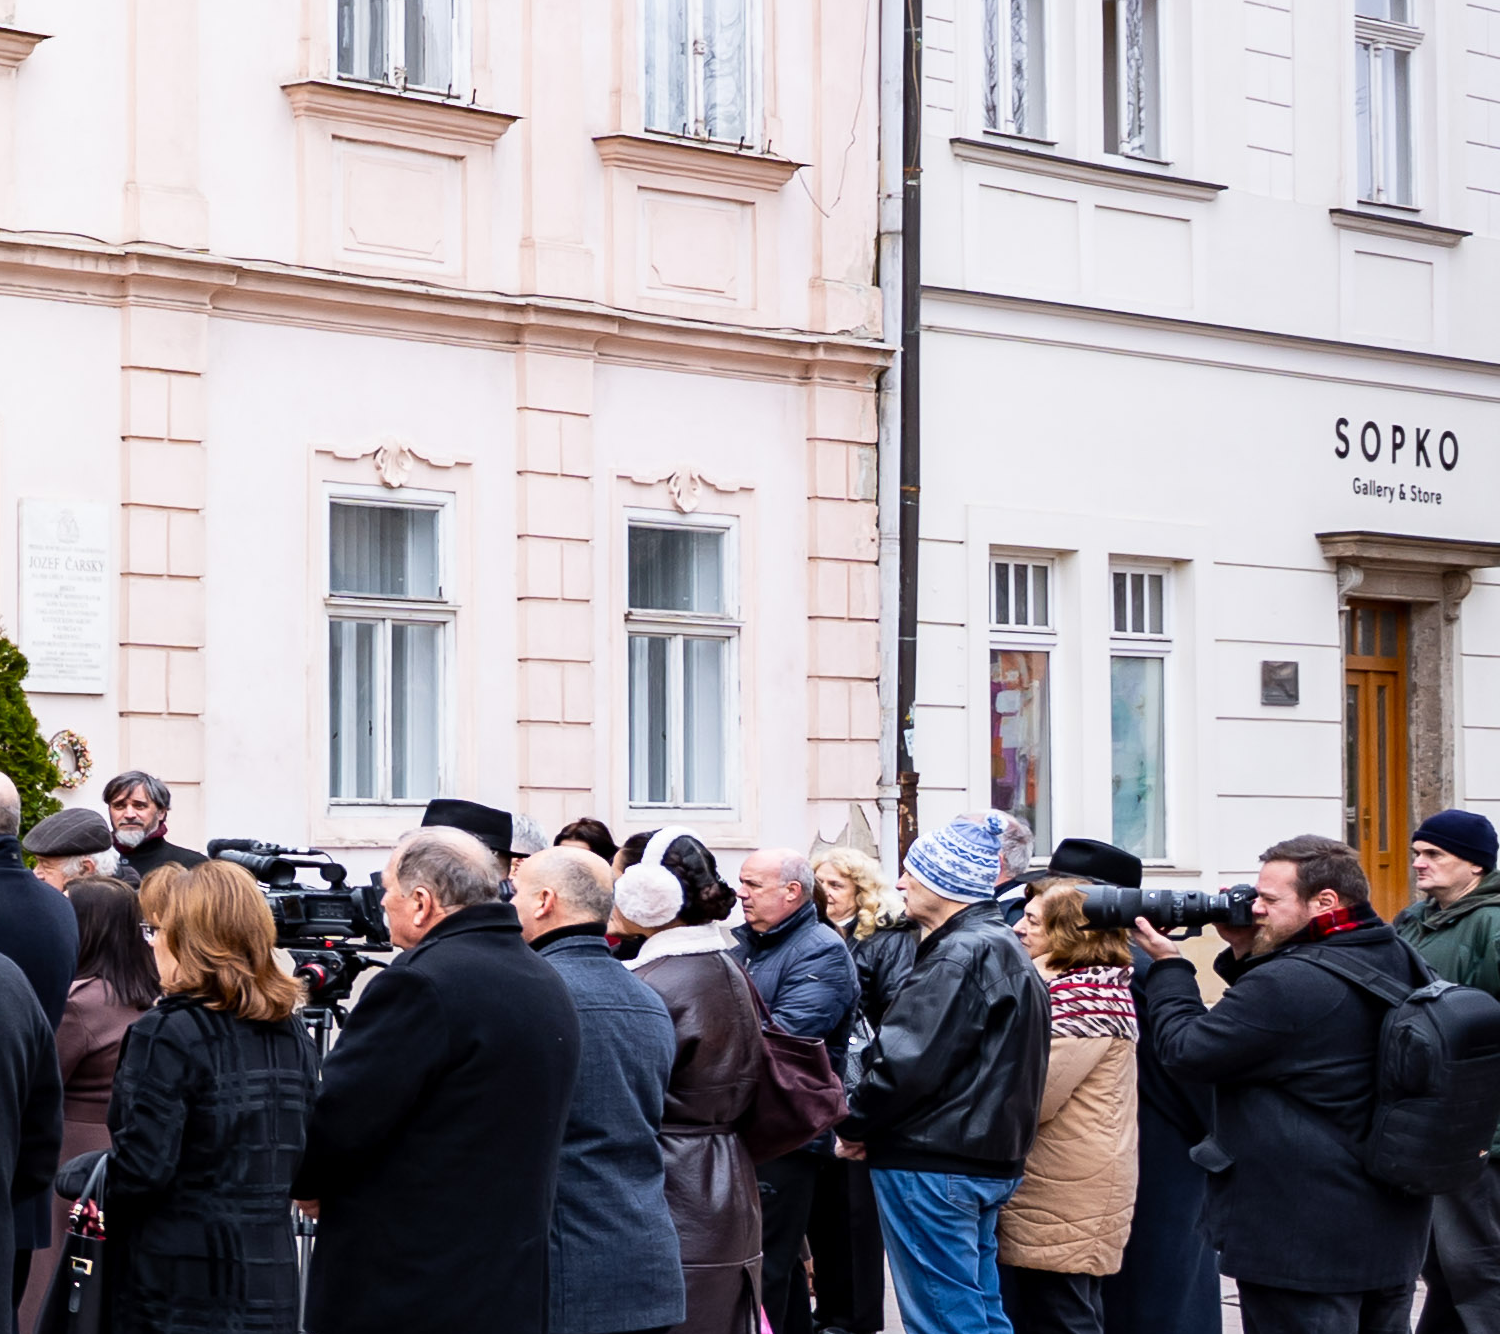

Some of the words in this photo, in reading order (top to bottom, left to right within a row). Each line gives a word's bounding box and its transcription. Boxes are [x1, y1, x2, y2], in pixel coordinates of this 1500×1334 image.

[1334, 417, 1459, 471] SOPKO
[1352, 477, 1395, 503] Gallery
[1399, 483, 1406, 501] &
[1410, 485, 1442, 505] Store
